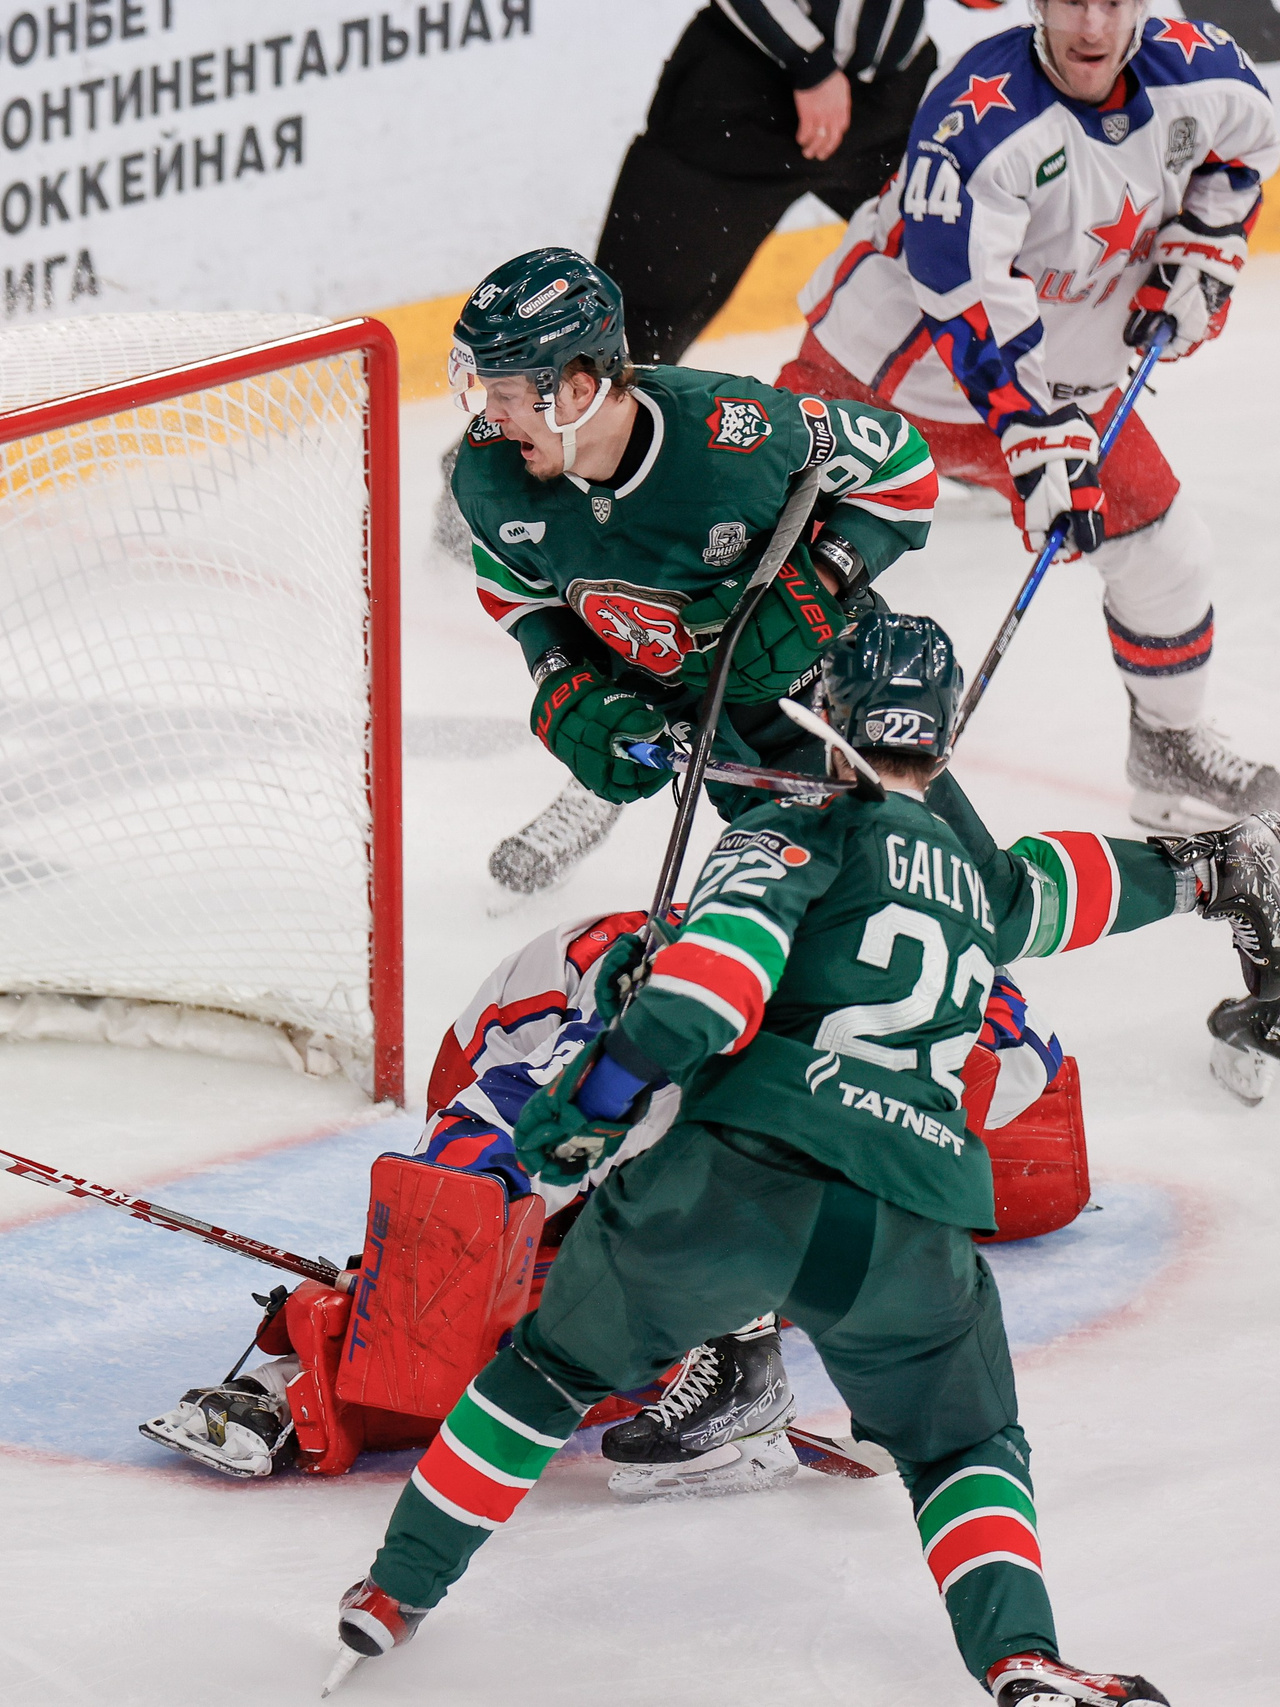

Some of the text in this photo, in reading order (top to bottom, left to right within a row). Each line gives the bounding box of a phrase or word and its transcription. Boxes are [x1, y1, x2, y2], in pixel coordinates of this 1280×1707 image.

[904, 156, 962, 224] 44
[472, 283, 503, 310] 96
[522, 289, 556, 314] Winline
[539, 320, 580, 345] BAUER
[807, 420, 830, 467] inline
[819, 407, 891, 497] 96
[882, 712, 921, 745] 22
[689, 849, 788, 913] 22
[885, 833, 996, 935] GALIYE
[813, 902, 995, 1111] 22
[838, 1081, 965, 1157] TATNEFT
[348, 1199, 391, 1364] TRUE
